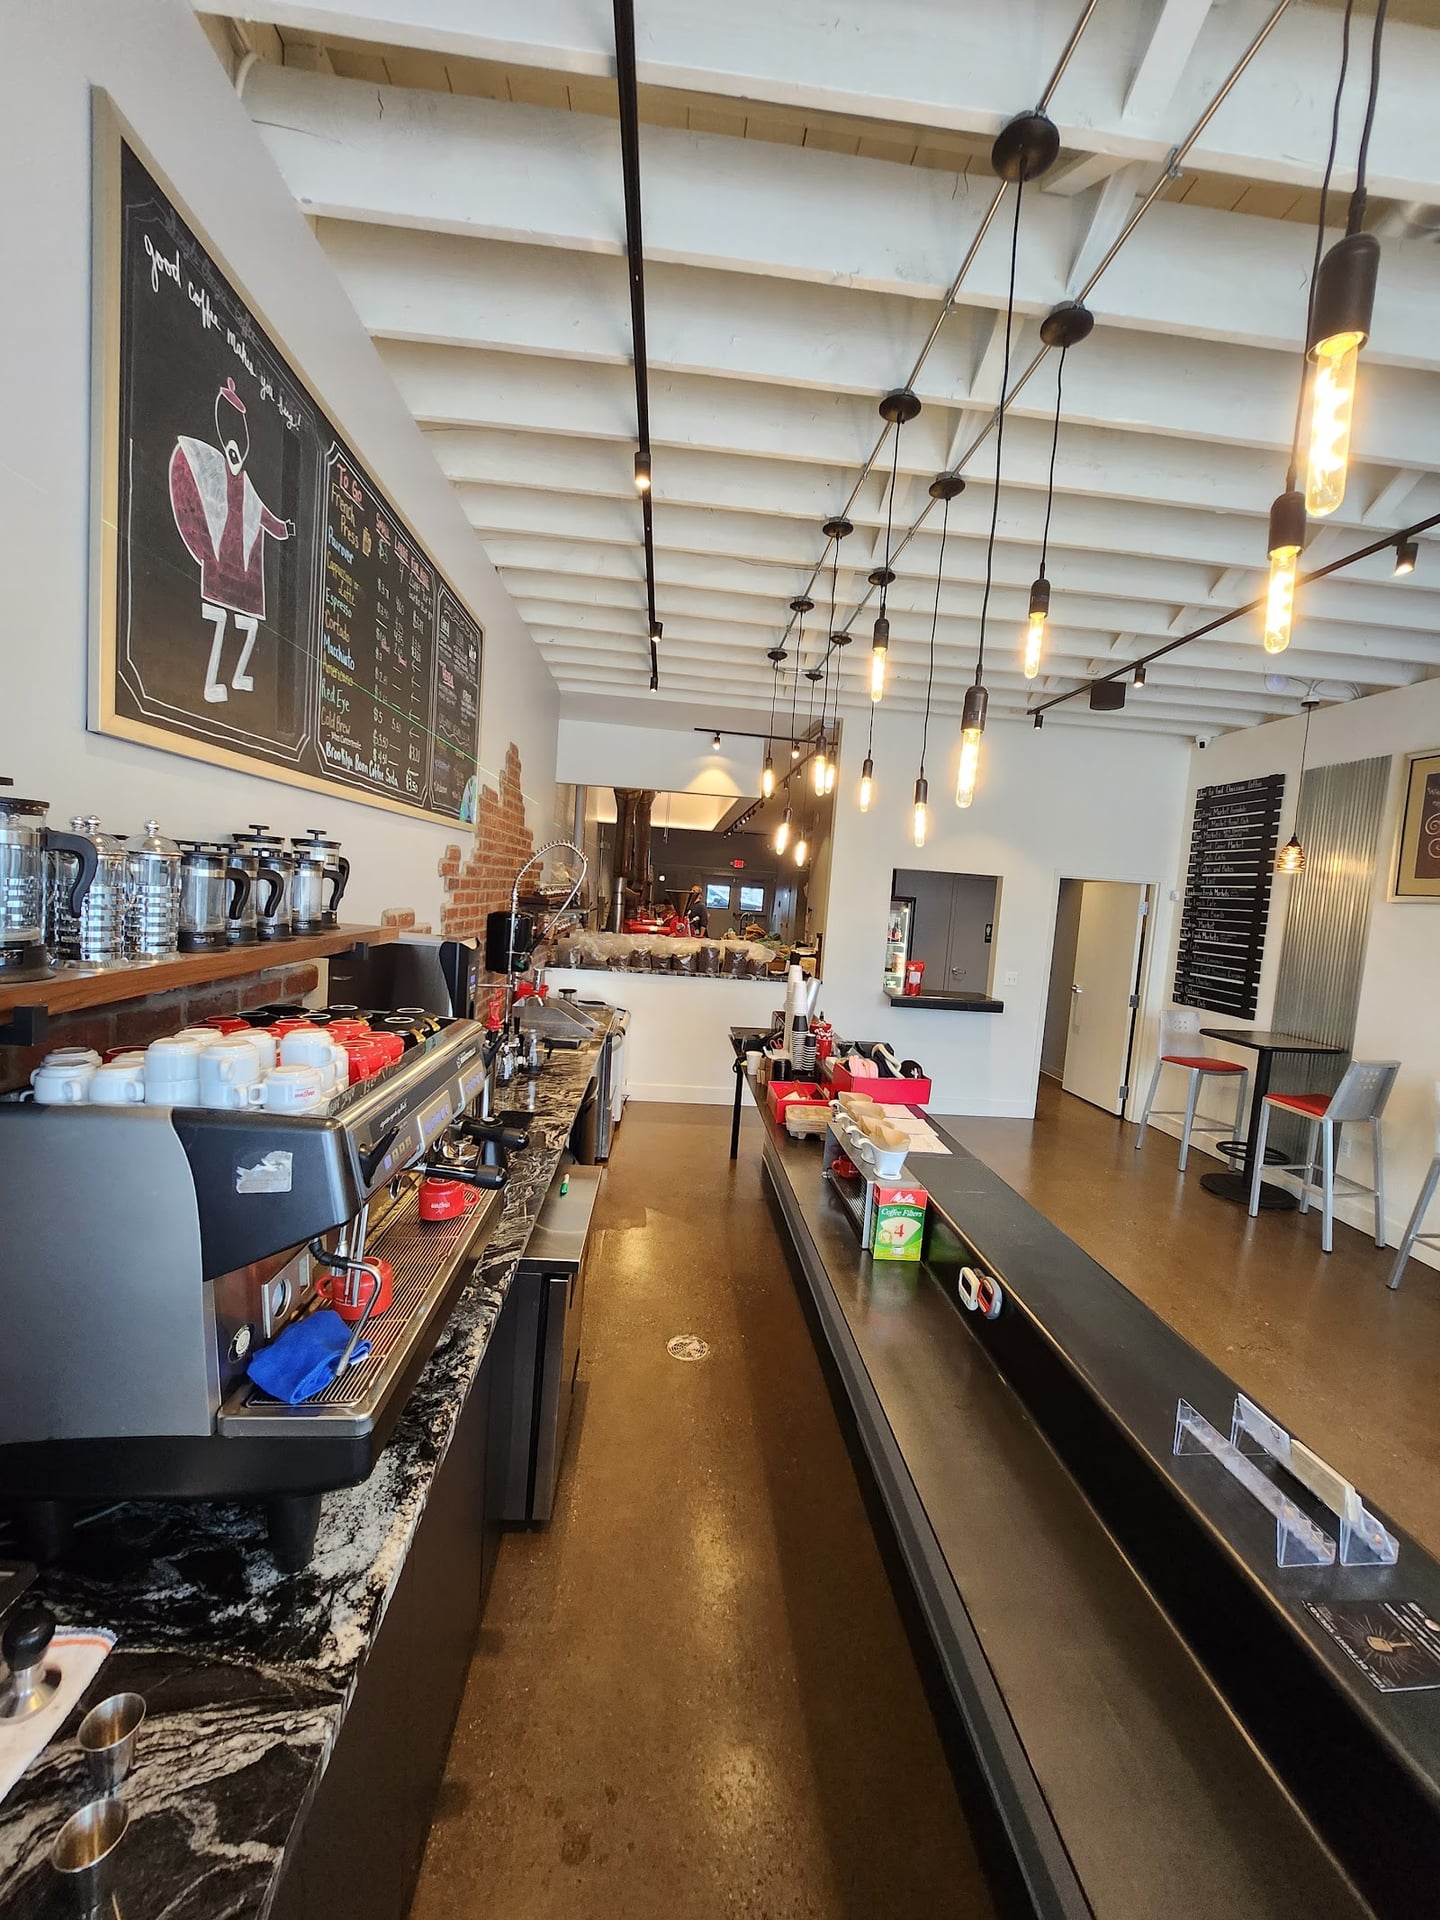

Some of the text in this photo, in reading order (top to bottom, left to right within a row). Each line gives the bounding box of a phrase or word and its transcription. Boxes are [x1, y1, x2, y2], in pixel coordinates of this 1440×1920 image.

[144, 234, 182, 293] good
[188, 281, 222, 331] coffee
[227, 328, 257, 378] makes
[260, 375, 276, 402] you
[337, 463, 349, 489] To
[331, 482, 356, 528] French
[341, 514, 359, 549] Press
[326, 587, 352, 618] Espresso
[324, 609, 350, 643] Cortado
[321, 677, 336, 704] Red
[336, 689, 351, 714] Eye
[321, 706, 351, 735] Cold Brew
[881, 1208, 923, 1218] Coffee Filters
[894, 1223, 905, 1238] 4
